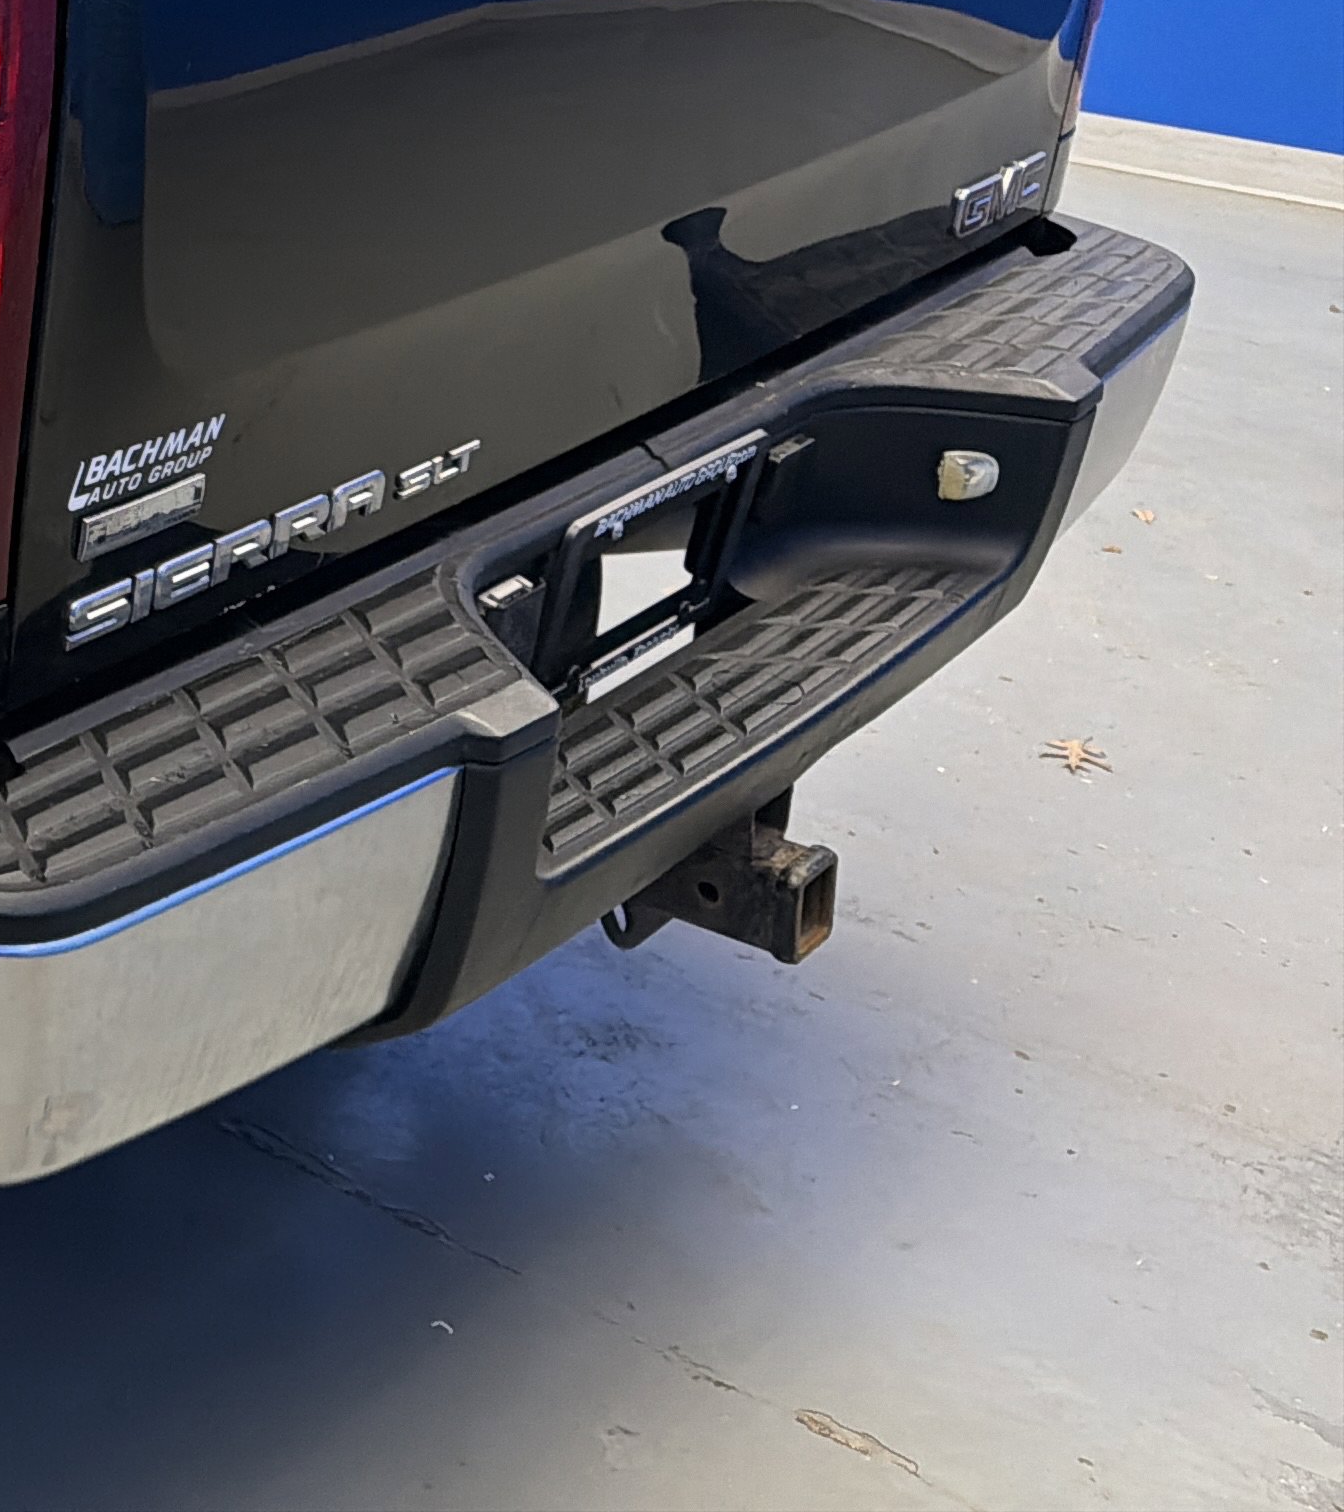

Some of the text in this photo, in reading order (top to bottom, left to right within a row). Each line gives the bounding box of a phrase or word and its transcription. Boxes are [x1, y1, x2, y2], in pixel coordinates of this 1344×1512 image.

[952, 150, 1047, 239] GMC
[82, 412, 226, 486] BACHMAN
[87, 445, 213, 506] AUTO GROUP
[65, 468, 386, 653] SIERRA
[395, 438, 482, 500] SLT
